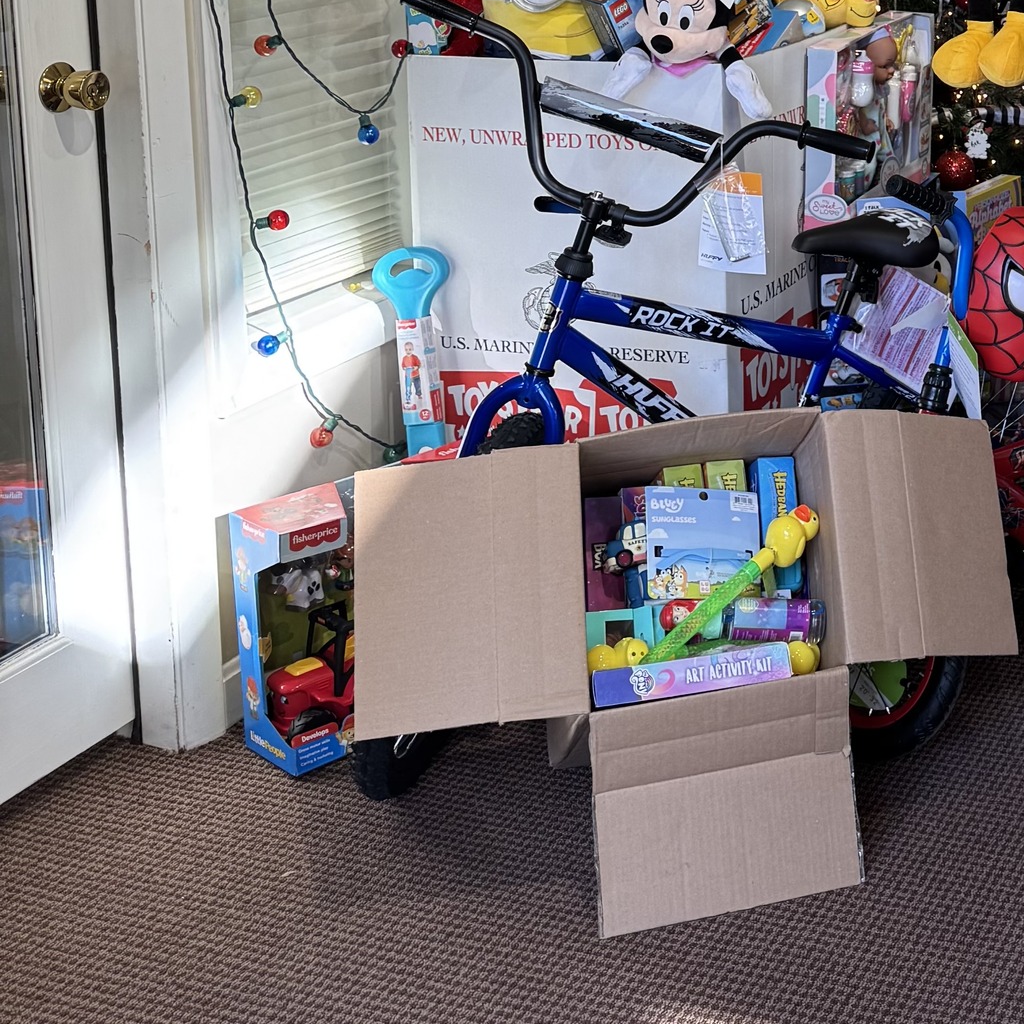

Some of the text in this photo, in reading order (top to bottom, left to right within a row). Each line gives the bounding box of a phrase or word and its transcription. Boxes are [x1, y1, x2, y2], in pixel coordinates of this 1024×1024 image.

[614, 3, 628, 17] LEGO
[422, 126, 466, 146] NEW,
[469, 129, 582, 149] UNWRPED
[585, 133, 634, 150] TOYS
[812, 201, 843, 213] Sweet
[741, 290, 763, 315] U.S.
[765, 260, 807, 303] MARINE
[631, 306, 739, 339] ROCK IT
[440, 335, 690, 364] U.S. MARIN RESERVE
[614, 373, 689, 422] HUFF
[771, 469, 789, 518] HEDBAN
[292, 527, 338, 544] fisher-price
[685, 656, 773, 684] ART ACTIVITY KIT
[301, 728, 329, 743] Develops
[301, 759, 314, 767] Caring
